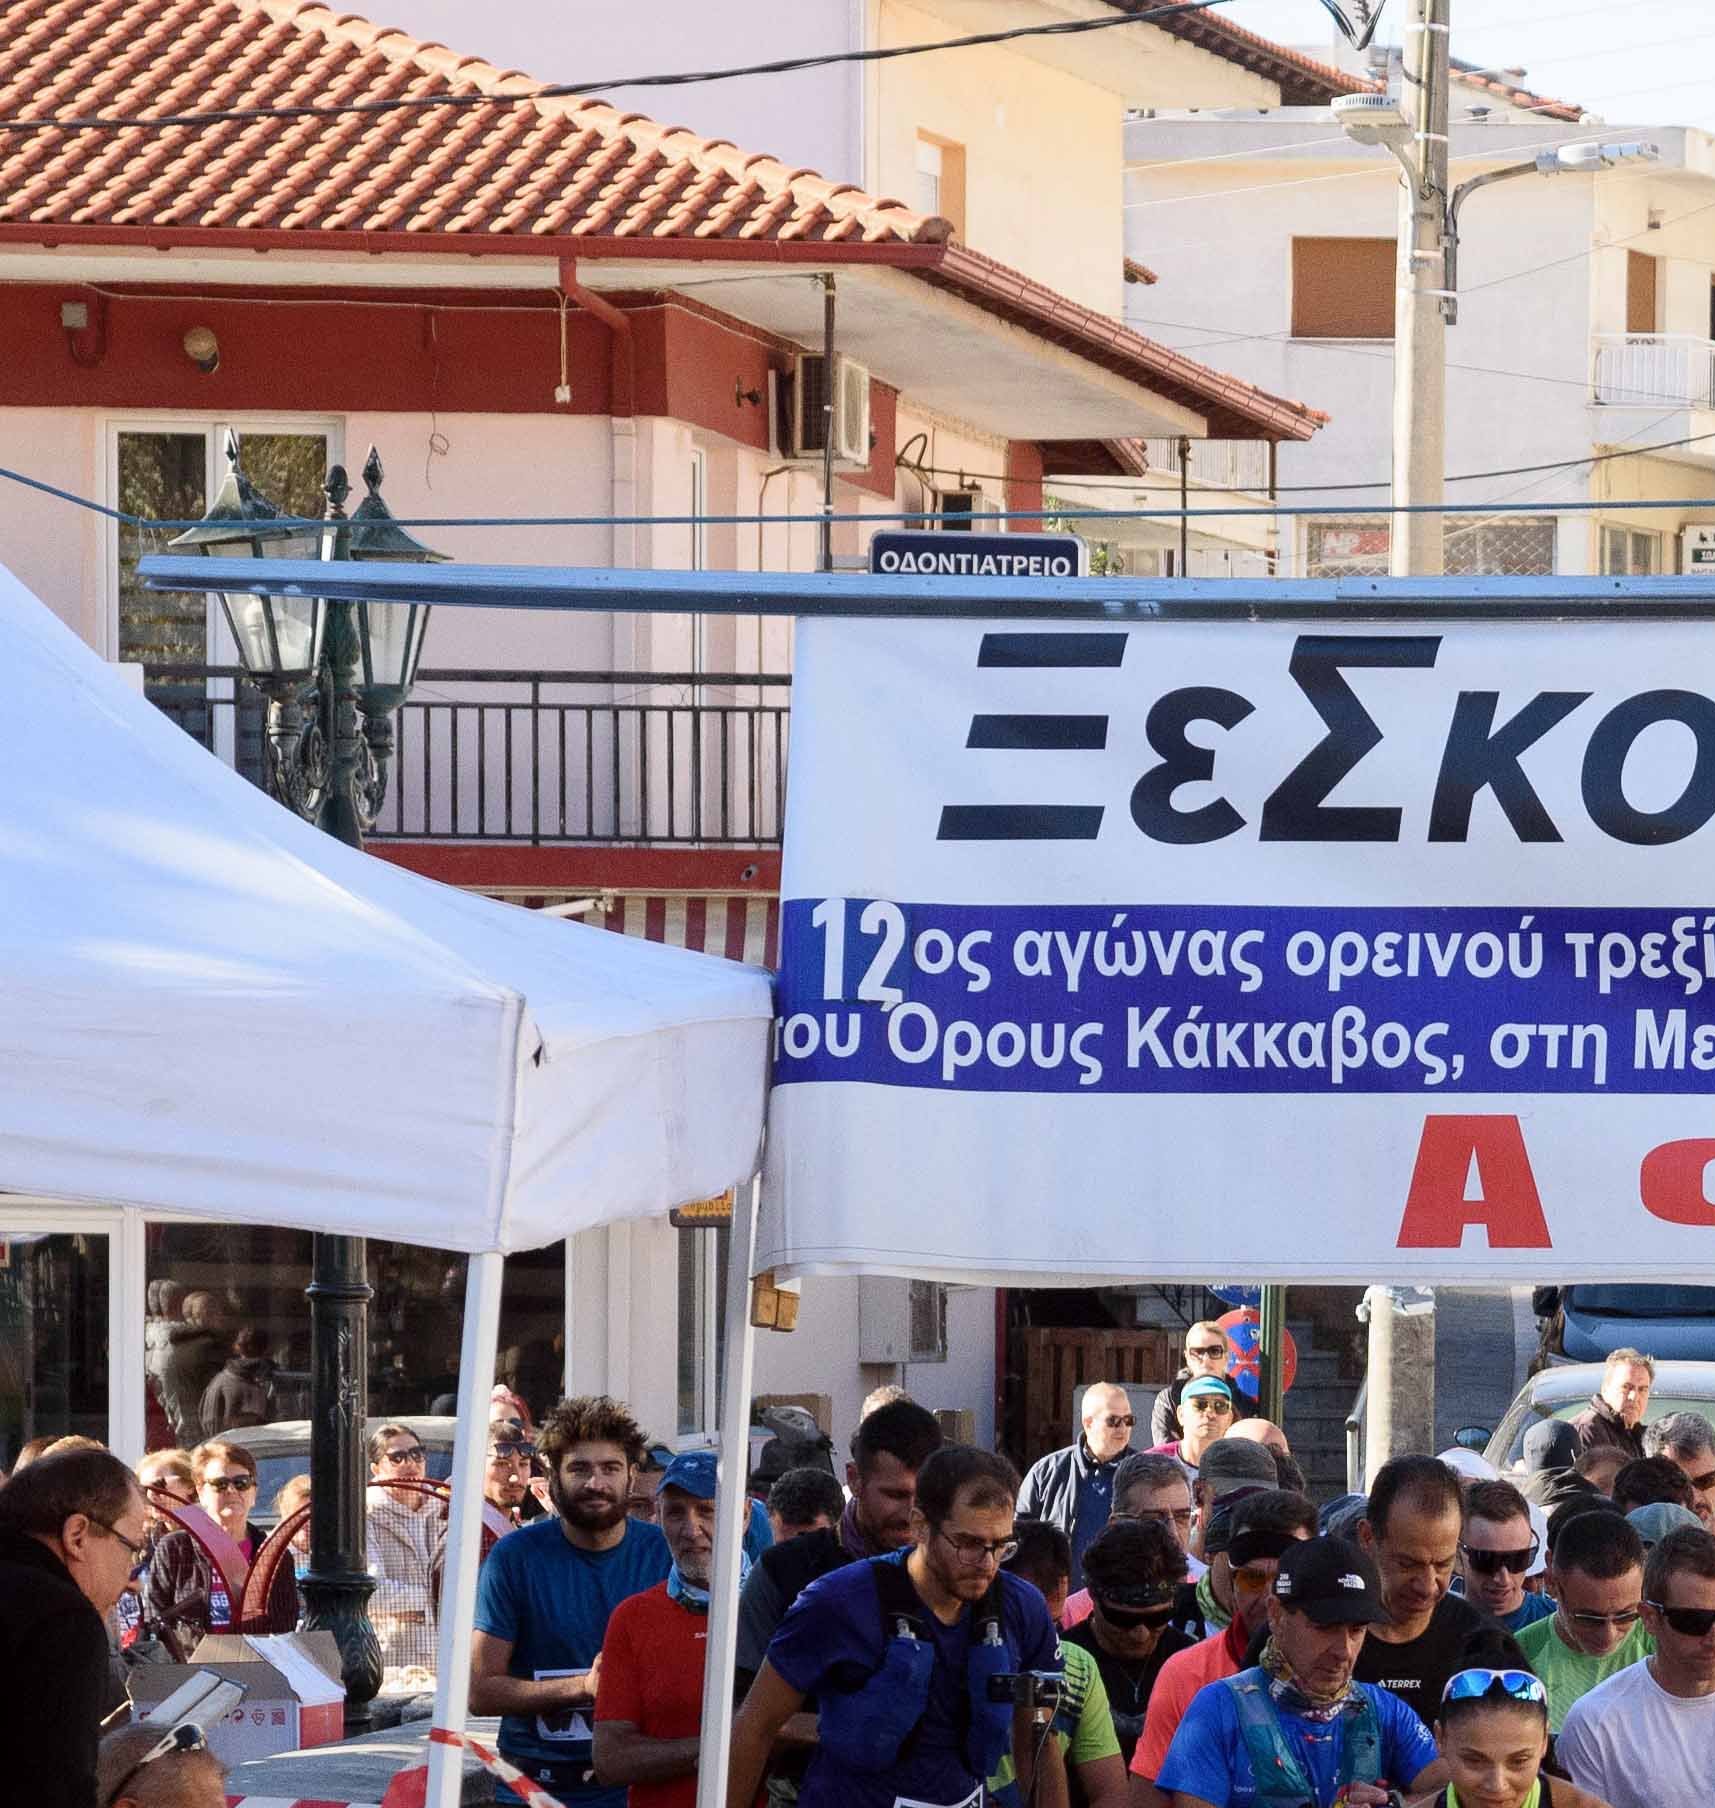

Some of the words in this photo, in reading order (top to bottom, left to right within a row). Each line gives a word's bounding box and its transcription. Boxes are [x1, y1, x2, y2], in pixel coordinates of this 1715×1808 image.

[880, 550, 1071, 577] ΟΔΟΝΤΙΑΤΡΕΙΟ
[812, 898, 993, 1002] 12ος
[1013, 913, 1264, 993] αγώνας
[1286, 916, 1544, 992] ορεινού
[881, 1000, 1103, 1085] Όρους
[1127, 1005, 1464, 1085] Κάκκαβος,
[1491, 1022, 1607, 1085] στη
[1386, 1679, 1422, 1689] TERREX
